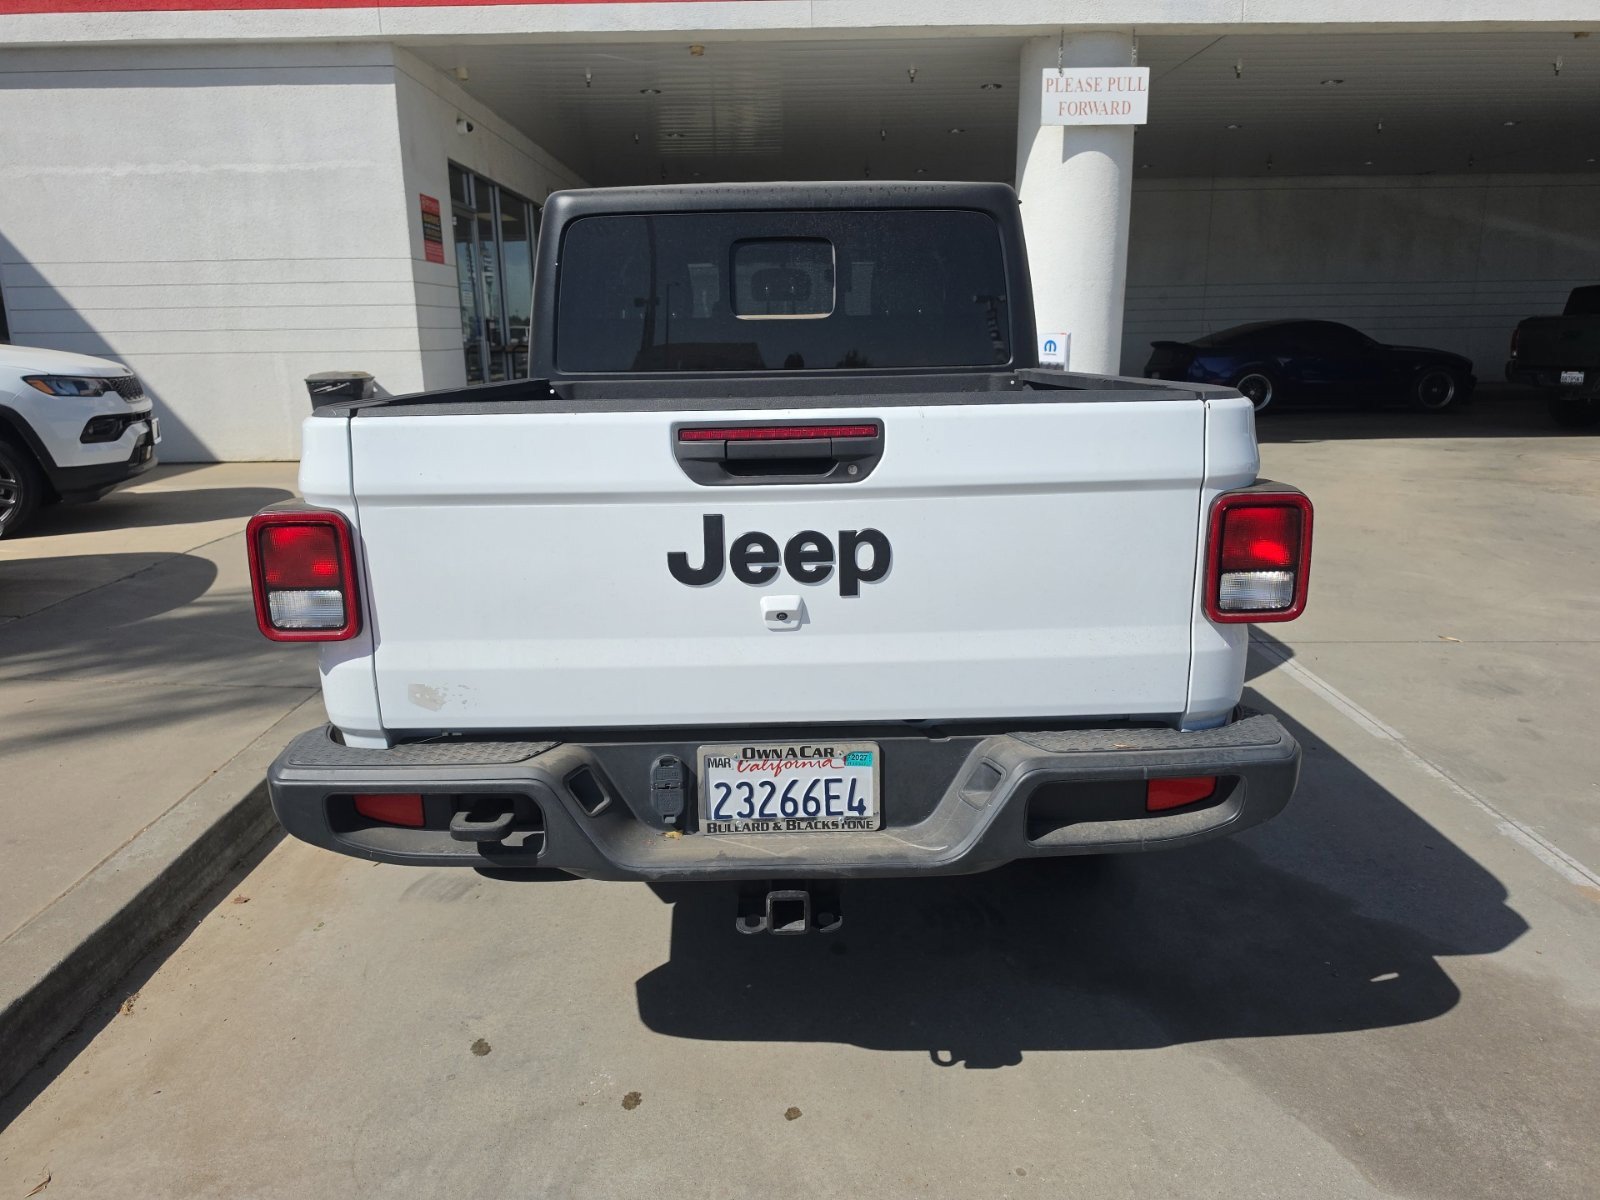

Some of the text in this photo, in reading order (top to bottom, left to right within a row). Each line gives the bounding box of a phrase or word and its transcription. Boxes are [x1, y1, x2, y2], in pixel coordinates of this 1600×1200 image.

[1045, 76, 1146, 93] PLEASE PULL
[1058, 100, 1132, 116] FORWARD
[667, 514, 891, 597] Jeep
[785, 747, 798, 759] A
[850, 754, 868, 762] 2027
[707, 758, 732, 769] MAR
[736, 758, 844, 778] California
[713, 777, 867, 820] 23266E4
[772, 820, 783, 832] &
